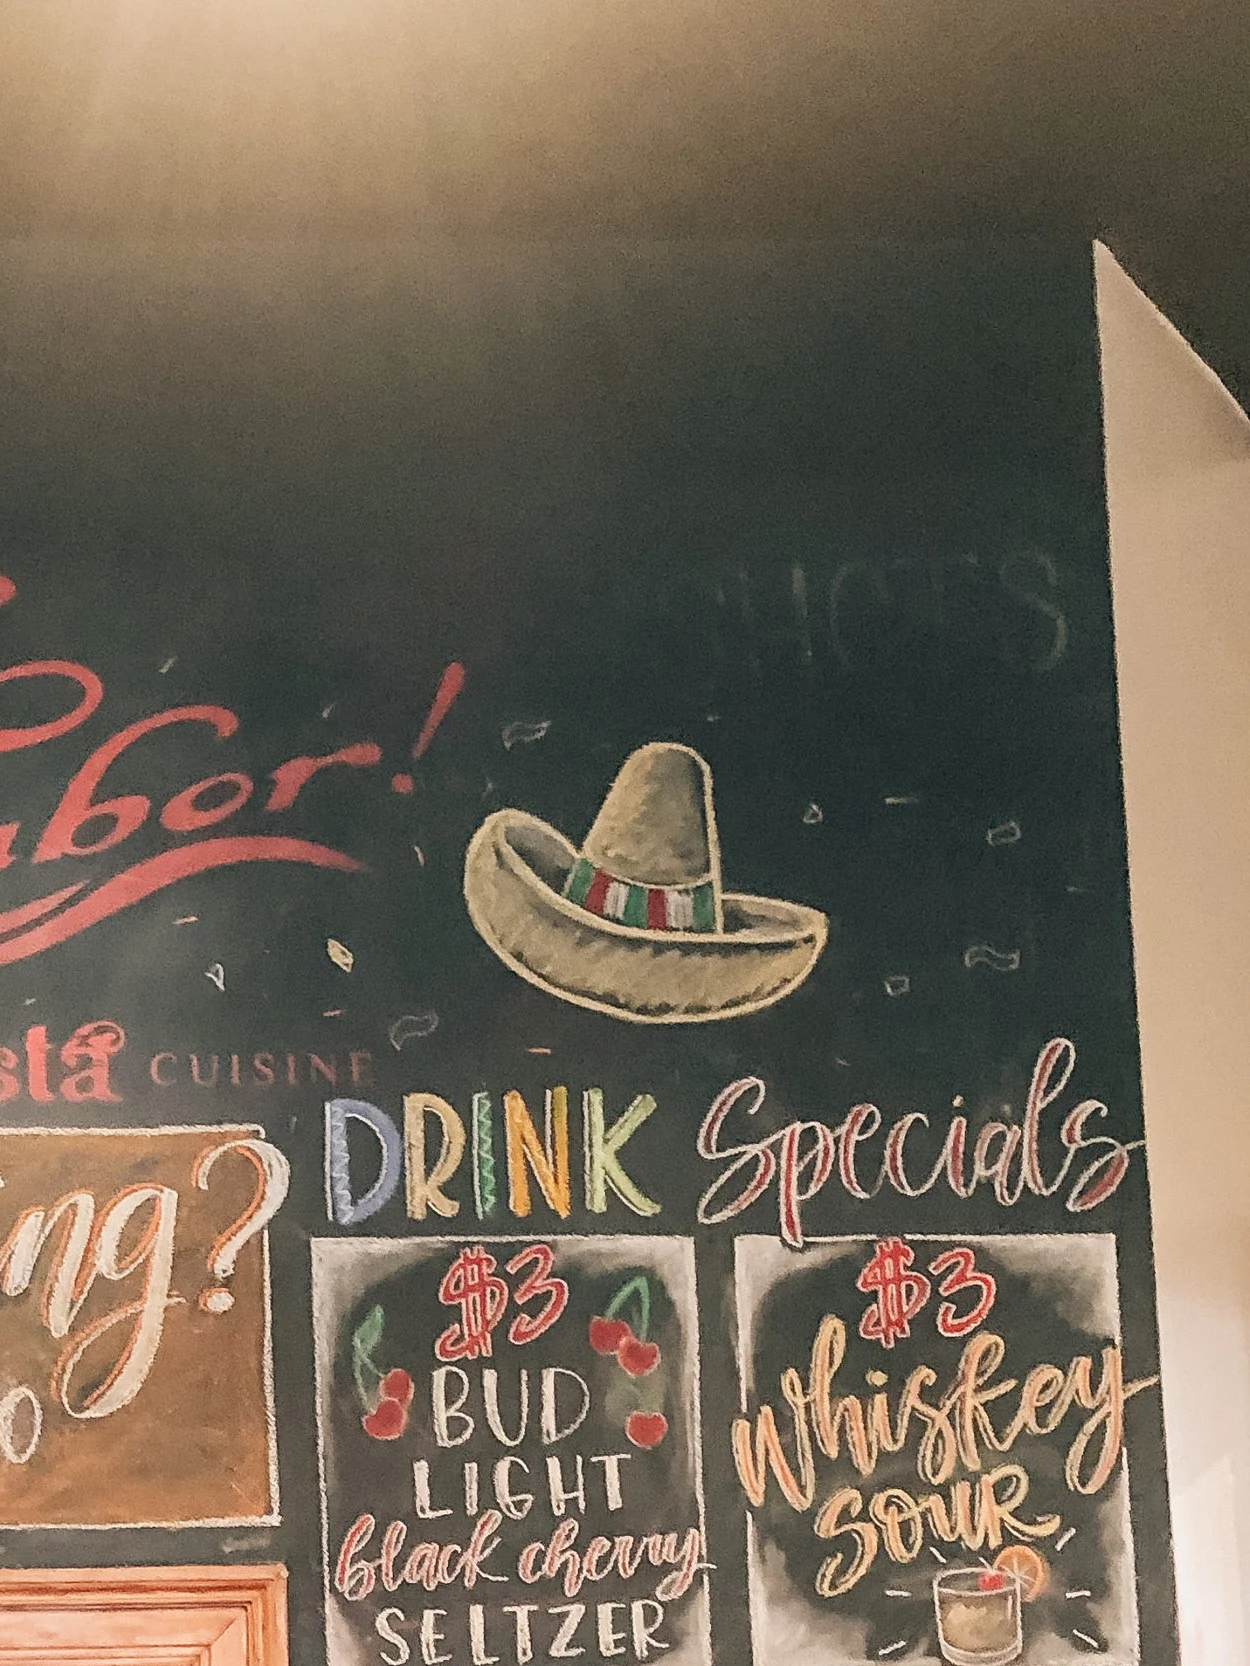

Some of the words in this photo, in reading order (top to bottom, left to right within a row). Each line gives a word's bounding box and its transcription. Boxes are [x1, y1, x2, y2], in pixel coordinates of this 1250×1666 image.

[151, 1050, 376, 1086] CUISINE
[325, 1086, 661, 1225] DRINK
[696, 1037, 1148, 1246] Specials
[434, 1243, 570, 1362] $3
[858, 1239, 997, 1348] $3
[431, 1364, 590, 1449] BUD
[413, 1452, 632, 1522] LIGHT
[334, 1511, 509, 1601] black
[519, 1527, 718, 1601] cherry
